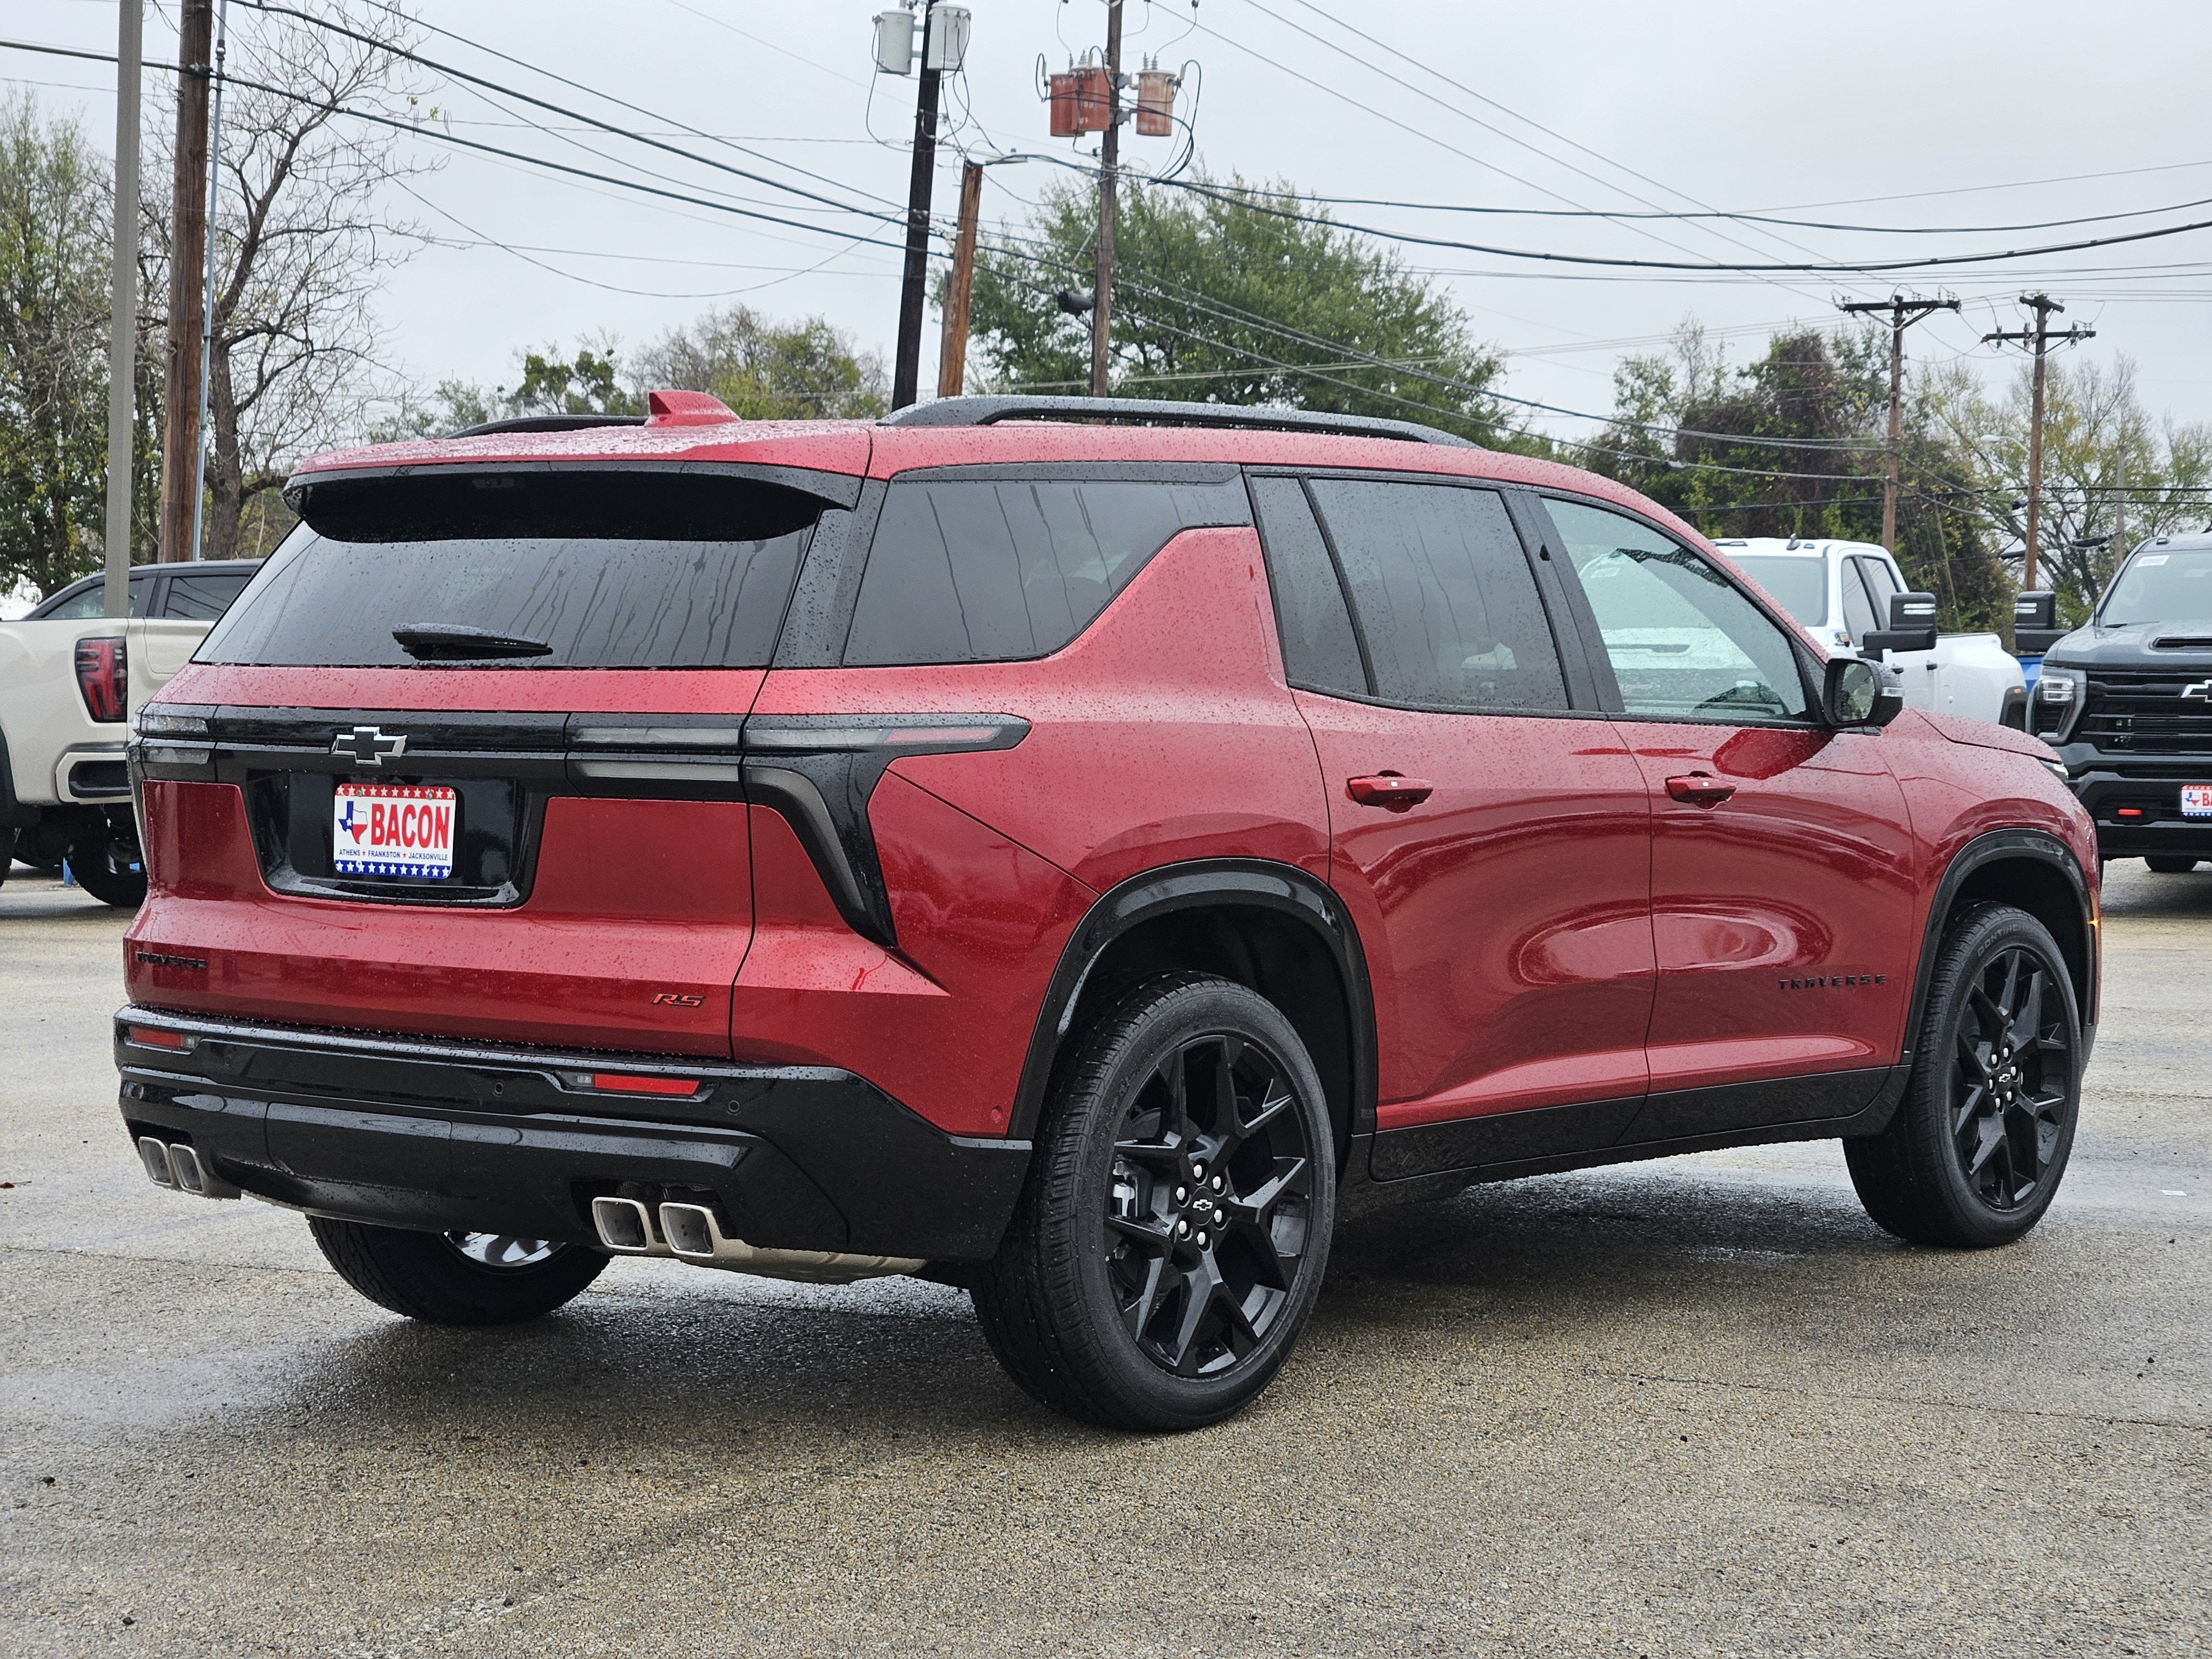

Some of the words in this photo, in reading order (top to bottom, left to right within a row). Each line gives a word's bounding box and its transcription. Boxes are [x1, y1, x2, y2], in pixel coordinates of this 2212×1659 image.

[371, 803, 450, 849] BACON
[368, 850, 401, 858] FRANKSTON
[408, 852, 448, 860] JACKSONVILLE
[1778, 974, 1887, 990] TRAVERSE
[650, 993, 706, 1007] RS
